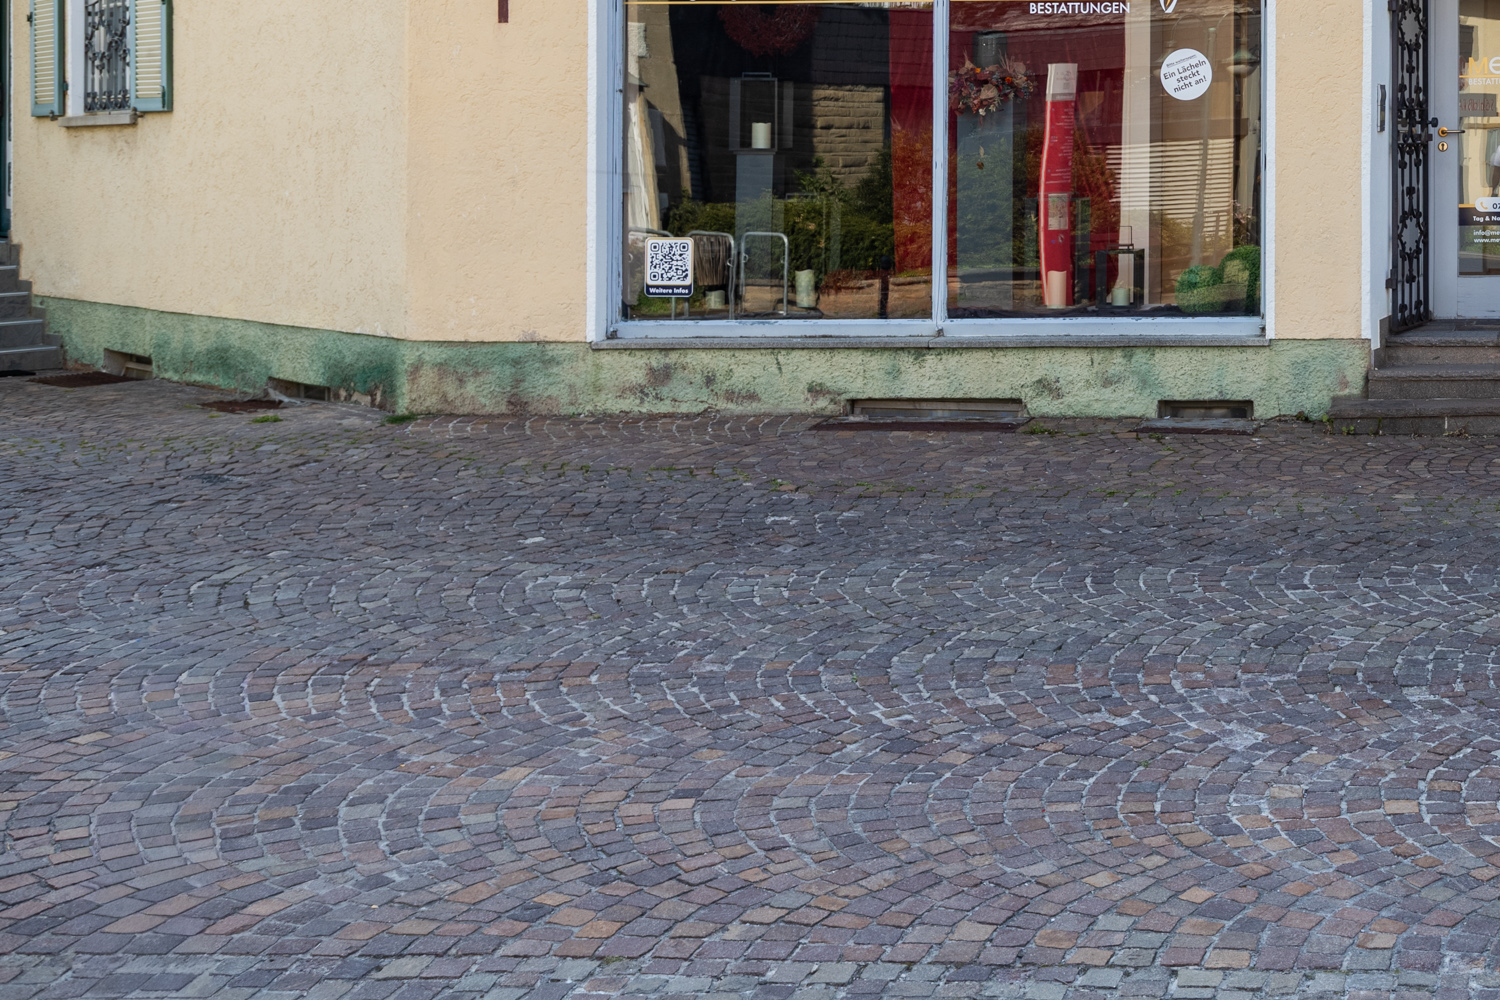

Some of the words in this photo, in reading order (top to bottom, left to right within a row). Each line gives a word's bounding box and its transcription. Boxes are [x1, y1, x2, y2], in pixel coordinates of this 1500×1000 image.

[1030, 2, 1130, 14] BESTATTUNGEN
[1163, 71, 1176, 80] Ein
[1177, 60, 1206, 74] Lächeln
[1176, 70, 1200, 84] steckt
[1174, 81, 1193, 92] nicht
[1194, 75, 1207, 86] an!
